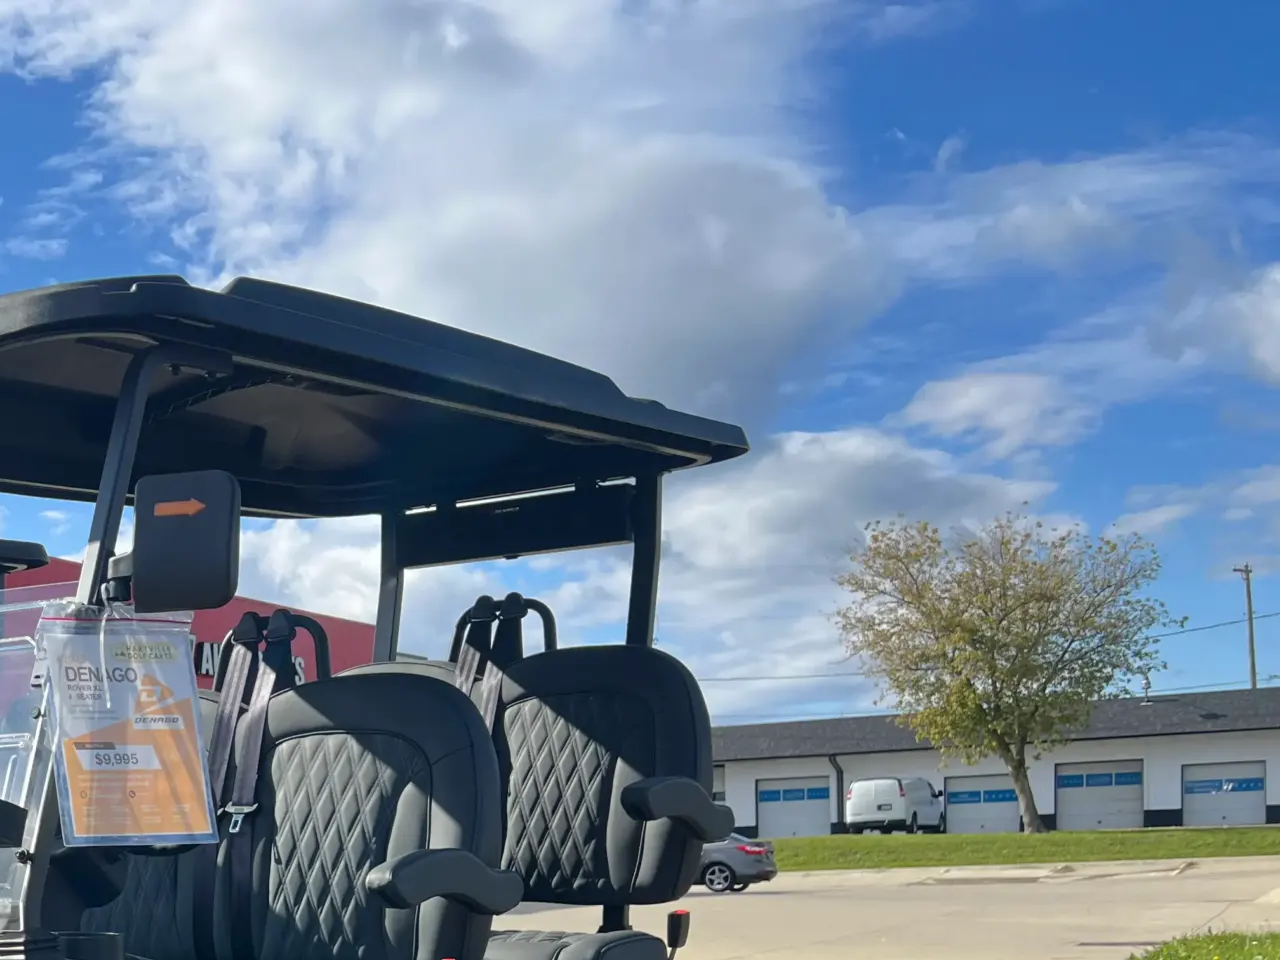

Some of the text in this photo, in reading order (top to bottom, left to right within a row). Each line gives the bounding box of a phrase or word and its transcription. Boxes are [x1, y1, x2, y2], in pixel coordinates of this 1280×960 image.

[65, 666, 138, 682] DENAGO
[67, 684, 92, 692] ROVER
[76, 693, 102, 701] SEATER
[134, 716, 179, 725] DENAGO
[95, 753, 139, 766] $9,995
